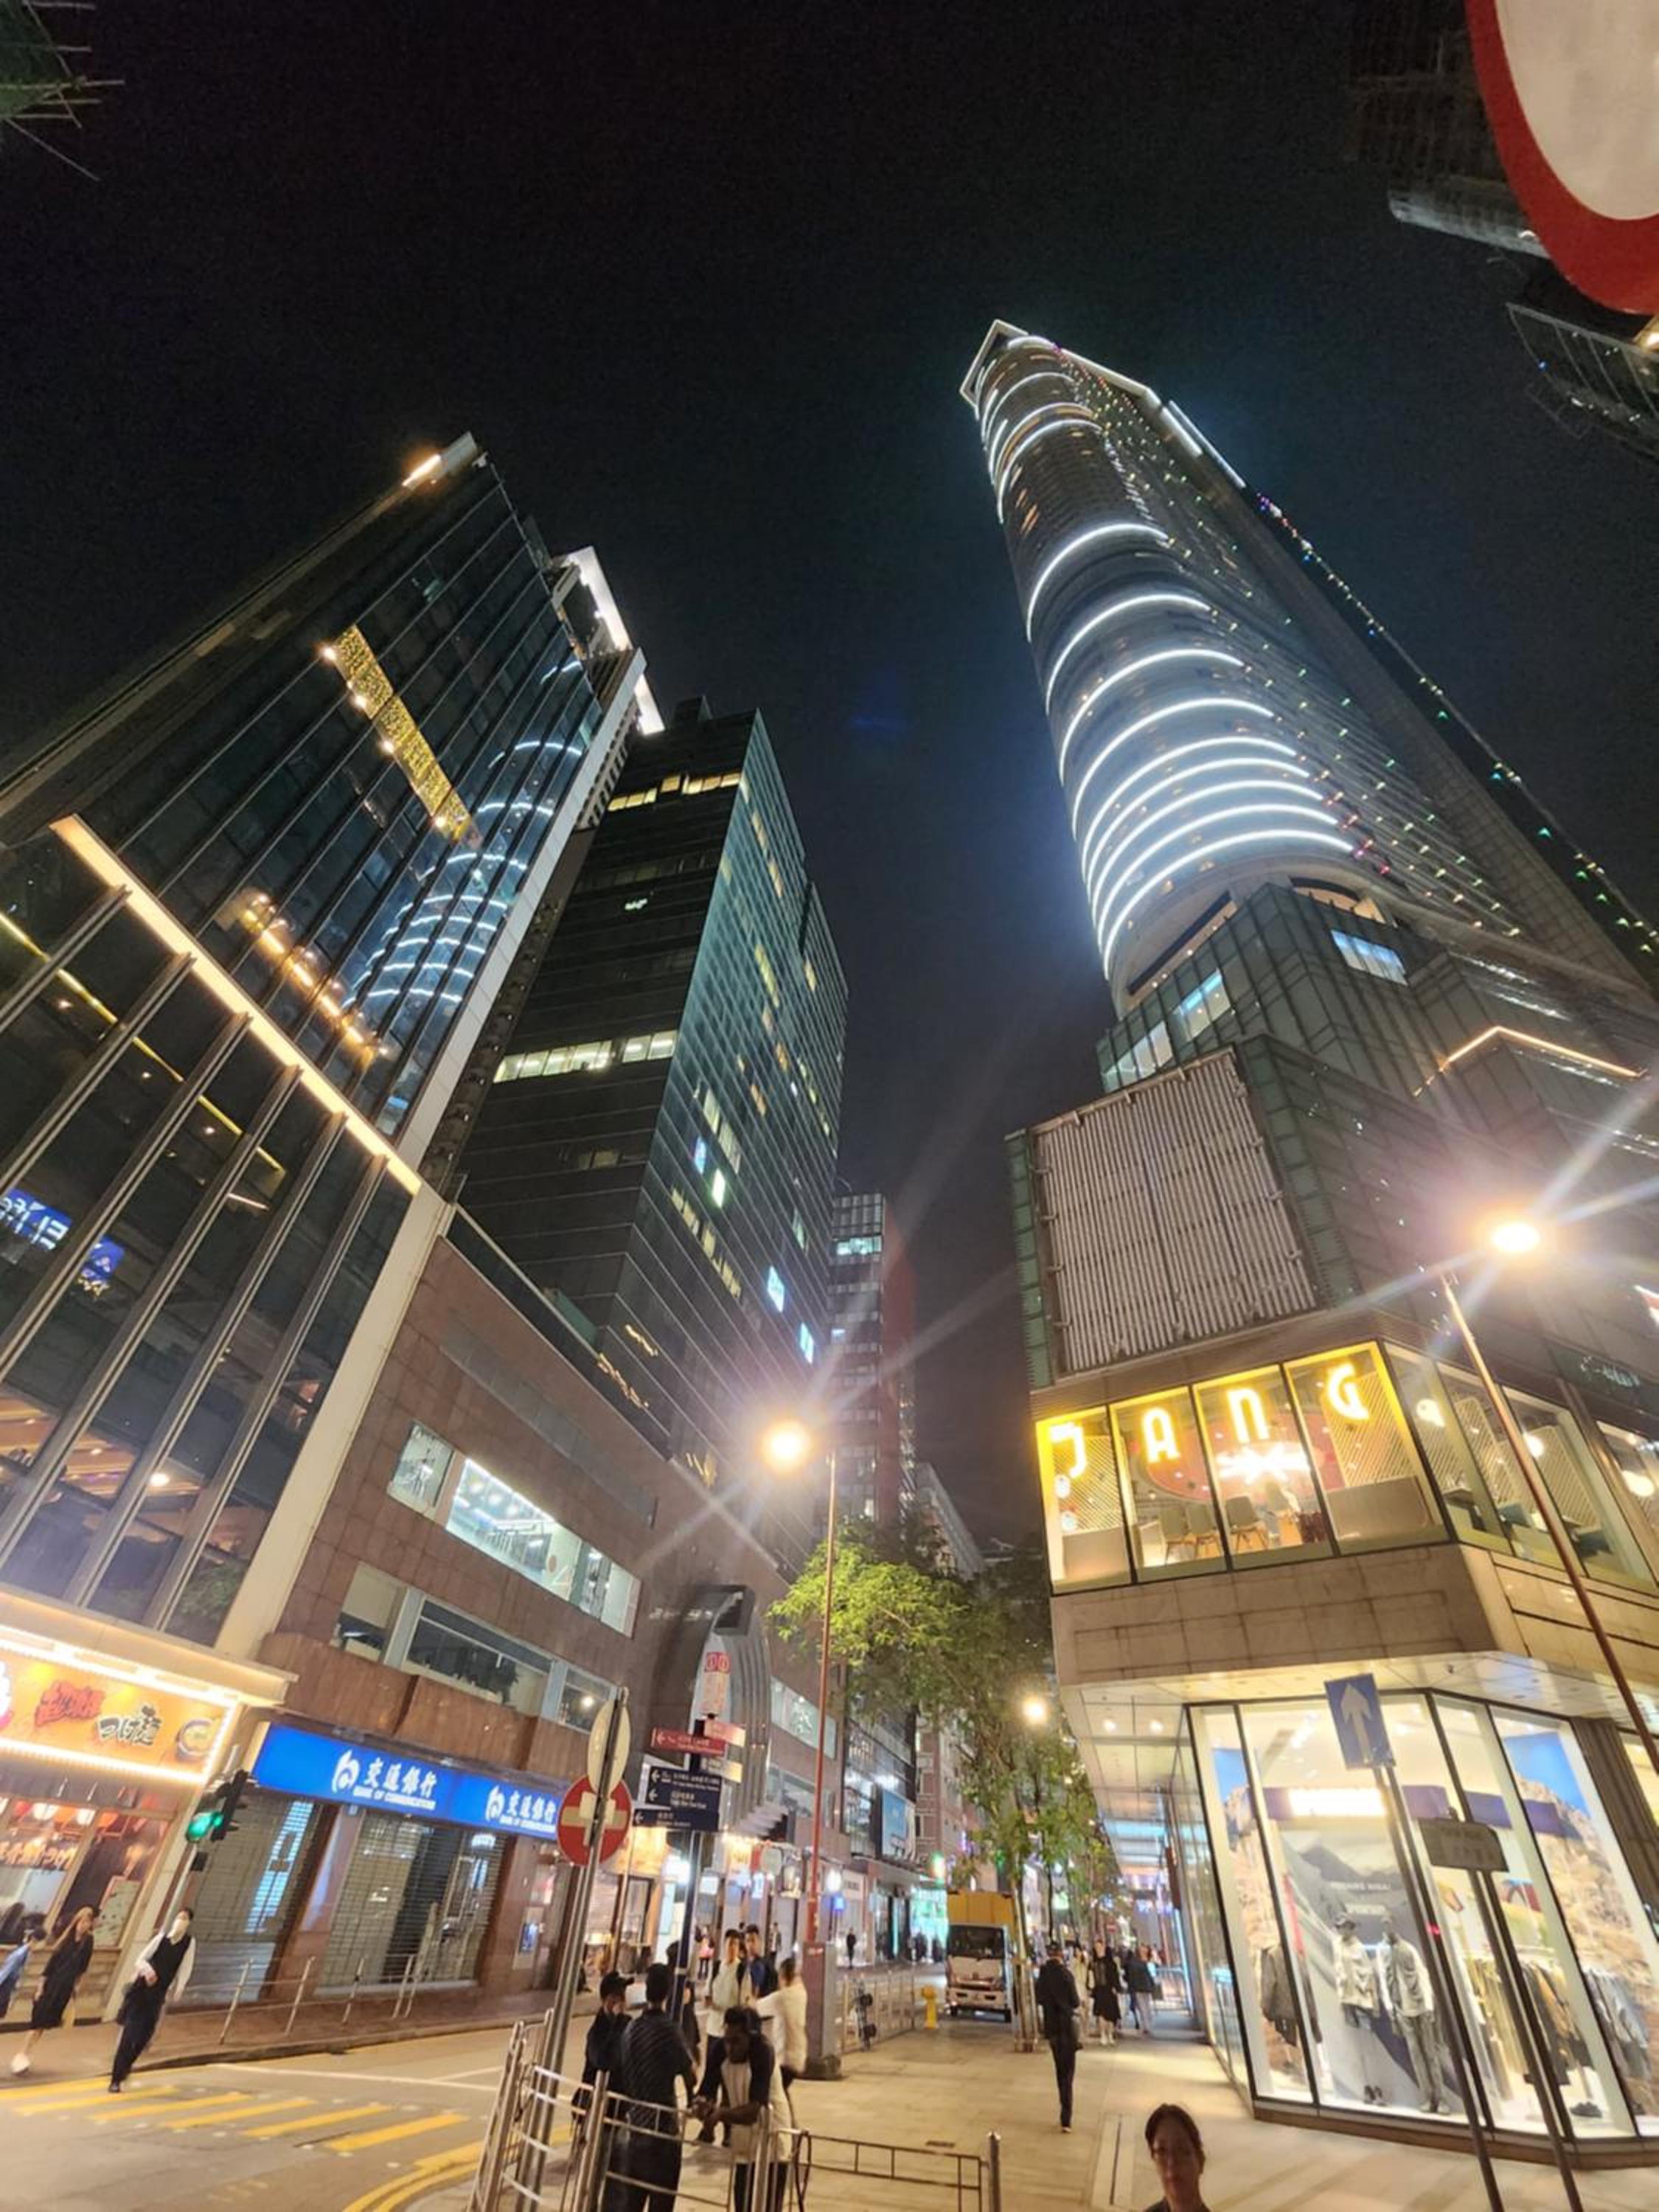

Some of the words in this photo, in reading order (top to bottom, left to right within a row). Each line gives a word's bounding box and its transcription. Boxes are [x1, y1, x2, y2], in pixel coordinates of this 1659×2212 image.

[1049, 1363, 1369, 1478] JANG
[364, 1757, 437, 1798] 交通銀行
